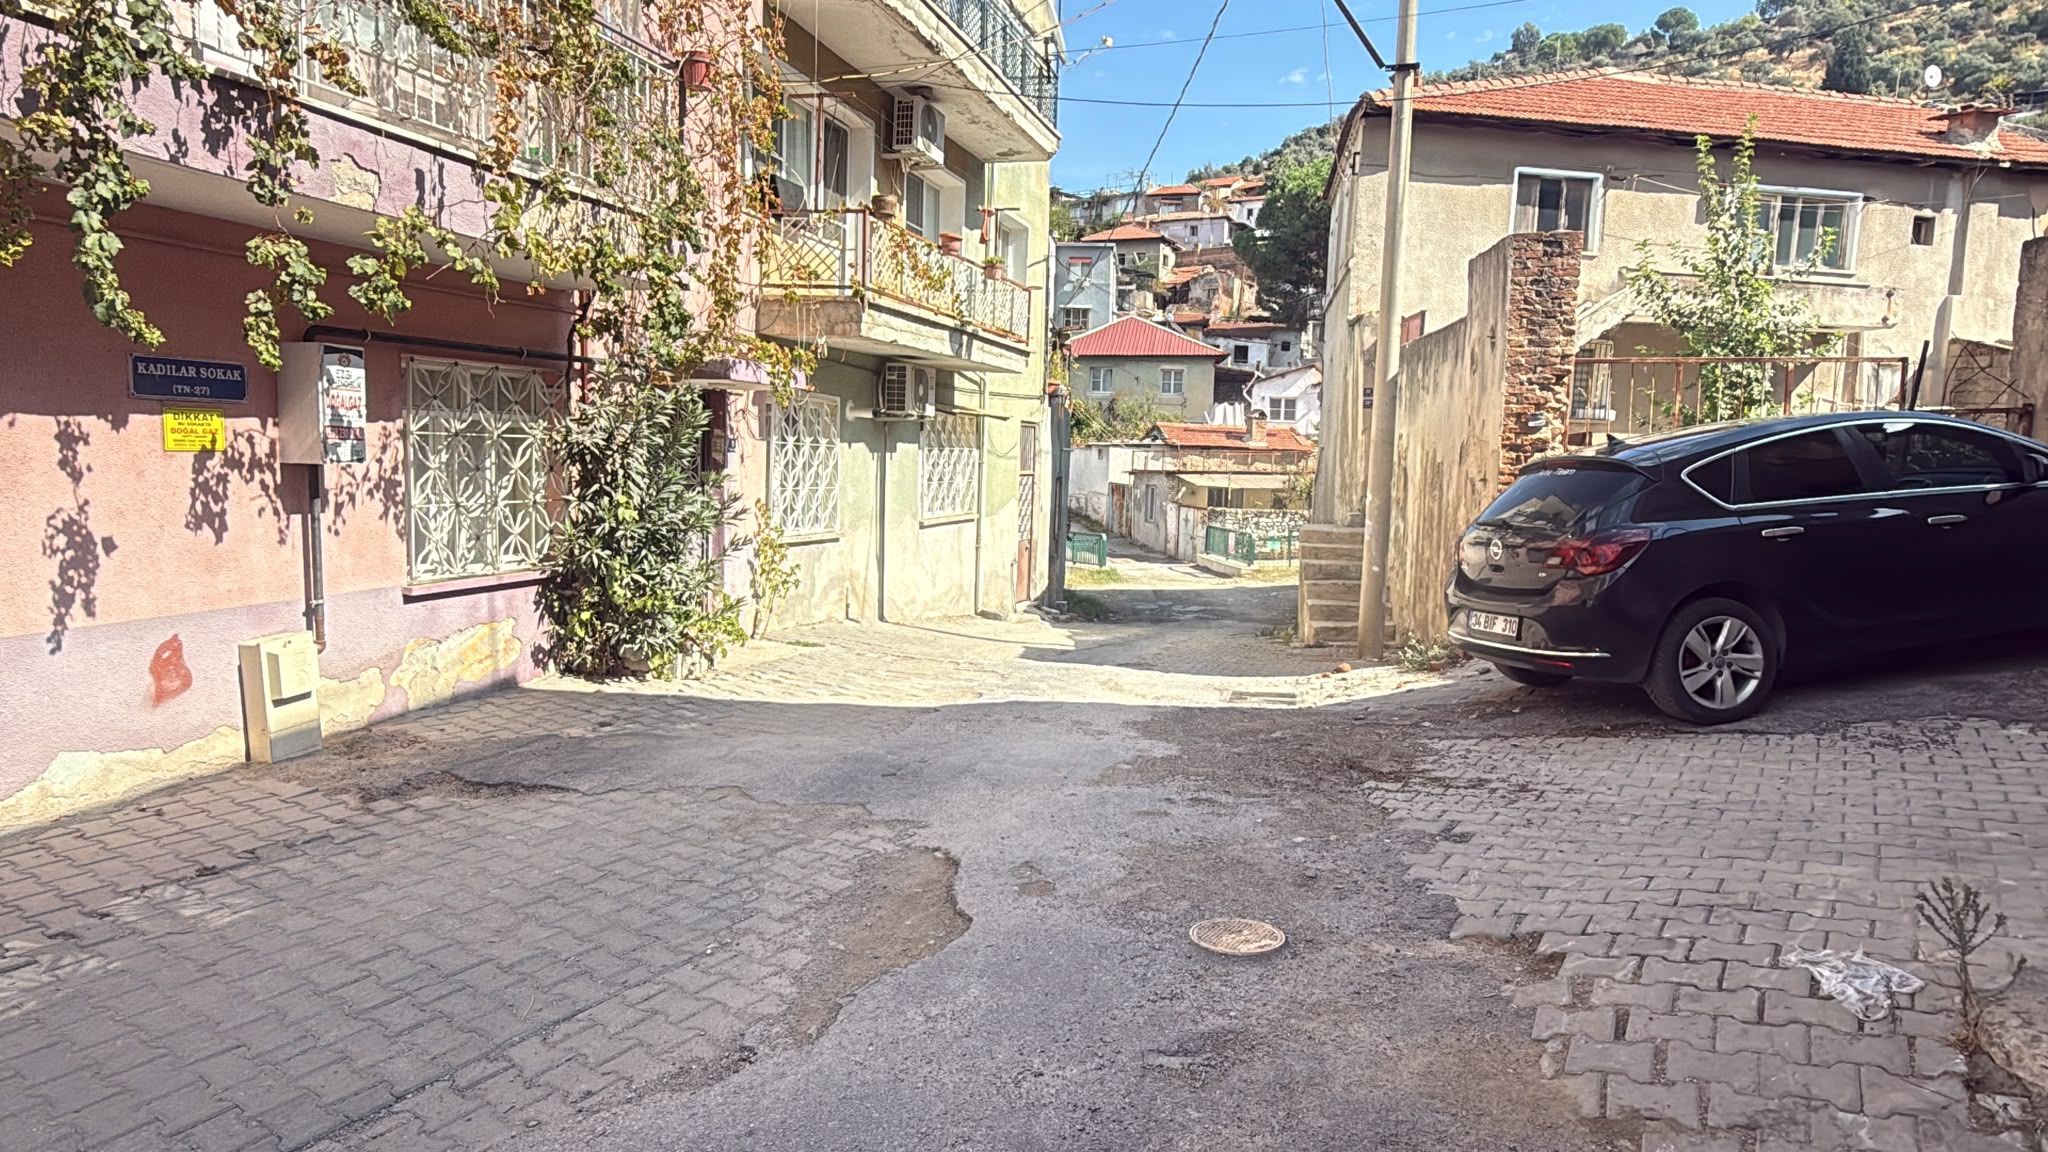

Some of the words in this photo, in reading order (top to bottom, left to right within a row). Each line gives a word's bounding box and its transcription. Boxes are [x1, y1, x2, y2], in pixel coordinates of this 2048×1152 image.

[136, 362, 197, 378] KADILAR
[199, 367, 242, 381] SOKAK
[172, 384, 210, 396] (TN-27)
[173, 410, 215, 422] DİKKAT
[170, 427, 200, 435] DOĞAL
[201, 428, 219, 436] GAZ
[1472, 612, 1482, 628] 34
[1483, 614, 1499, 631] BIF
[1501, 617, 1517, 635] 310
